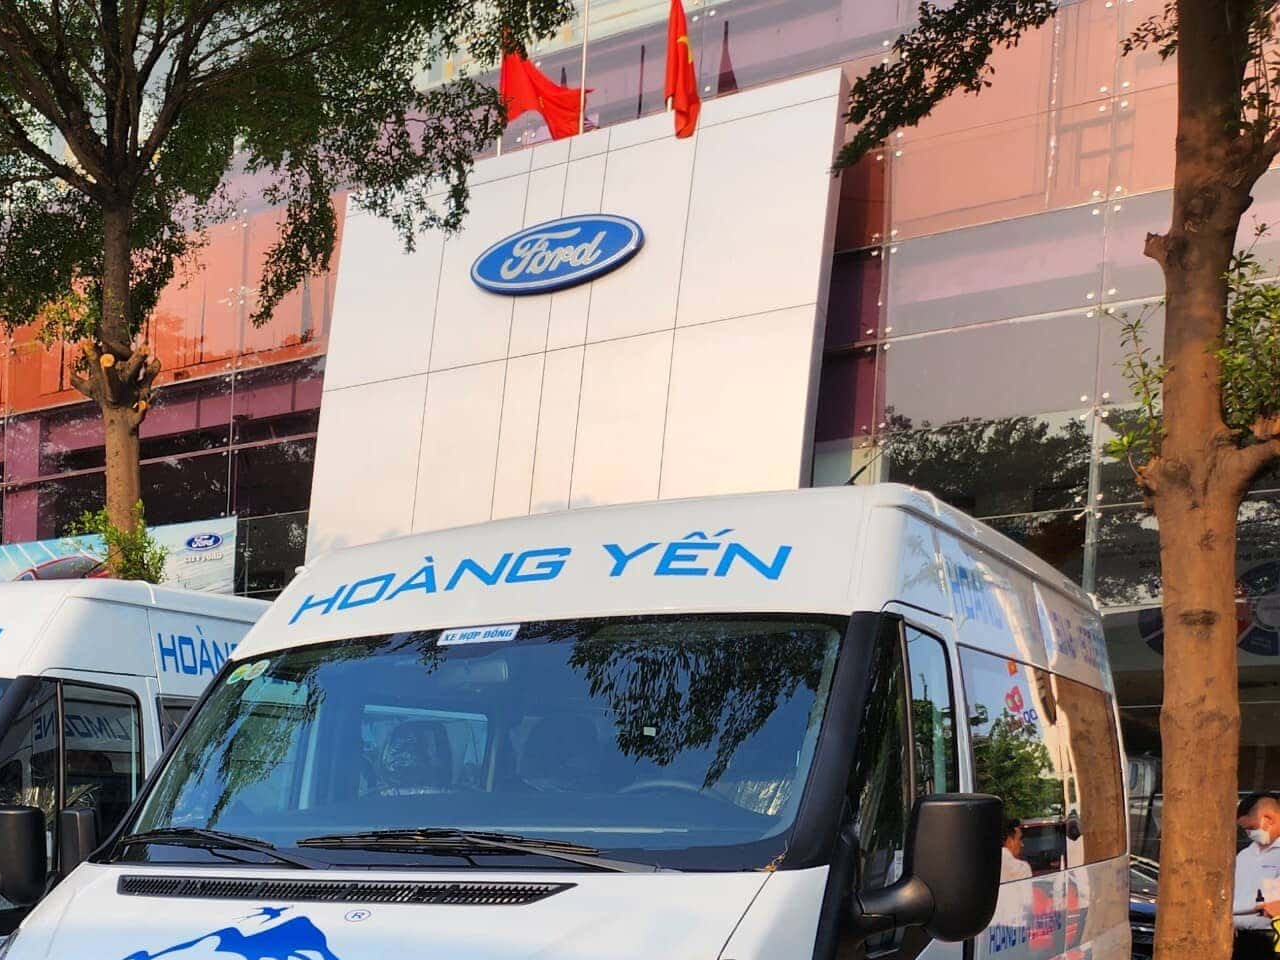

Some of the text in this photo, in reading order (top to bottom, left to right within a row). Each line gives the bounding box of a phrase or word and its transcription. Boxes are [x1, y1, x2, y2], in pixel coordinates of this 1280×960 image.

[500, 227, 608, 280] Ford
[289, 528, 792, 625] HOÀNG YẾN
